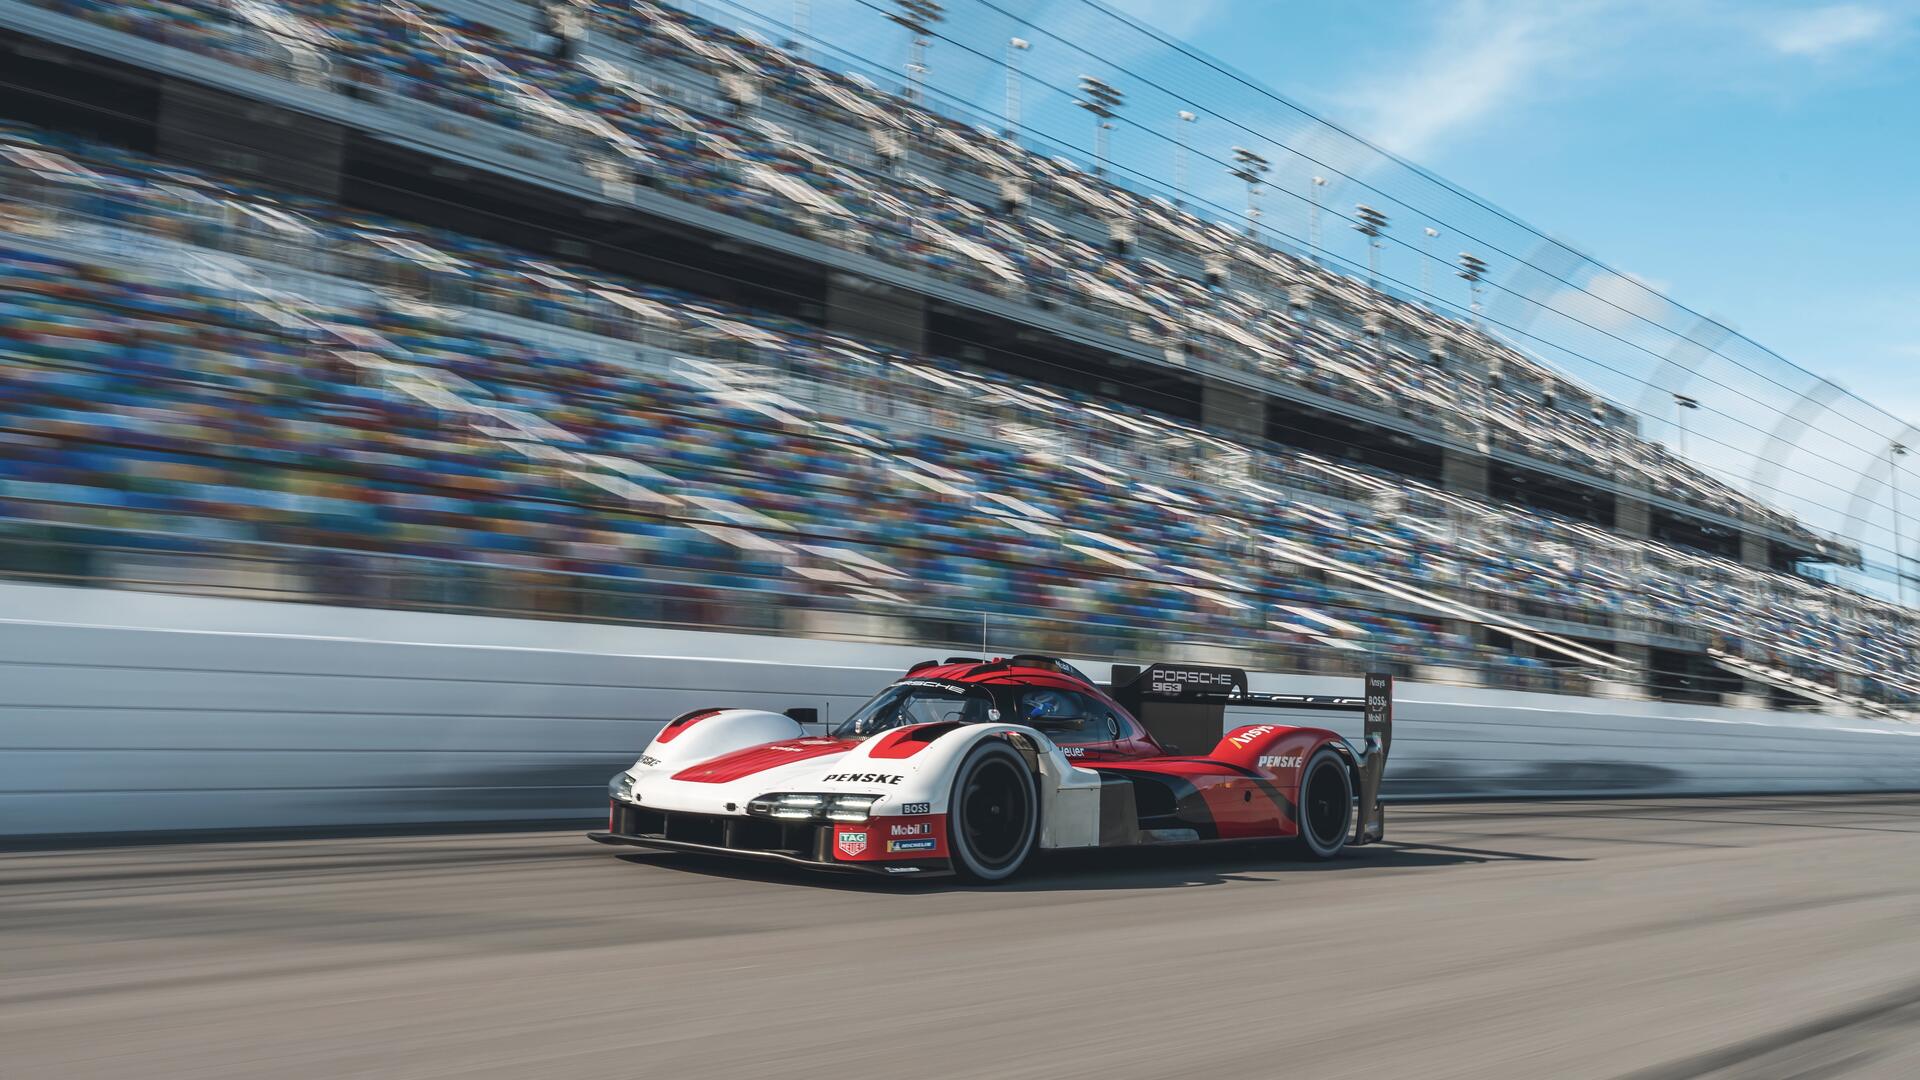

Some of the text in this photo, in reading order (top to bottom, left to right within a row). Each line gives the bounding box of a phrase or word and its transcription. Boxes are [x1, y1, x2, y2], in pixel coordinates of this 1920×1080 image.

[1153, 670, 1231, 685] PORSCHE
[1153, 682, 1182, 692] 963
[1370, 678, 1385, 688] Ansys
[1368, 696, 1384, 705] BOSS
[1258, 755, 1303, 768] PENSKE
[822, 774, 904, 785] PENSKE
[904, 803, 929, 813] BOSS
[891, 824, 920, 835] Mobil
[842, 834, 865, 842] TAG
